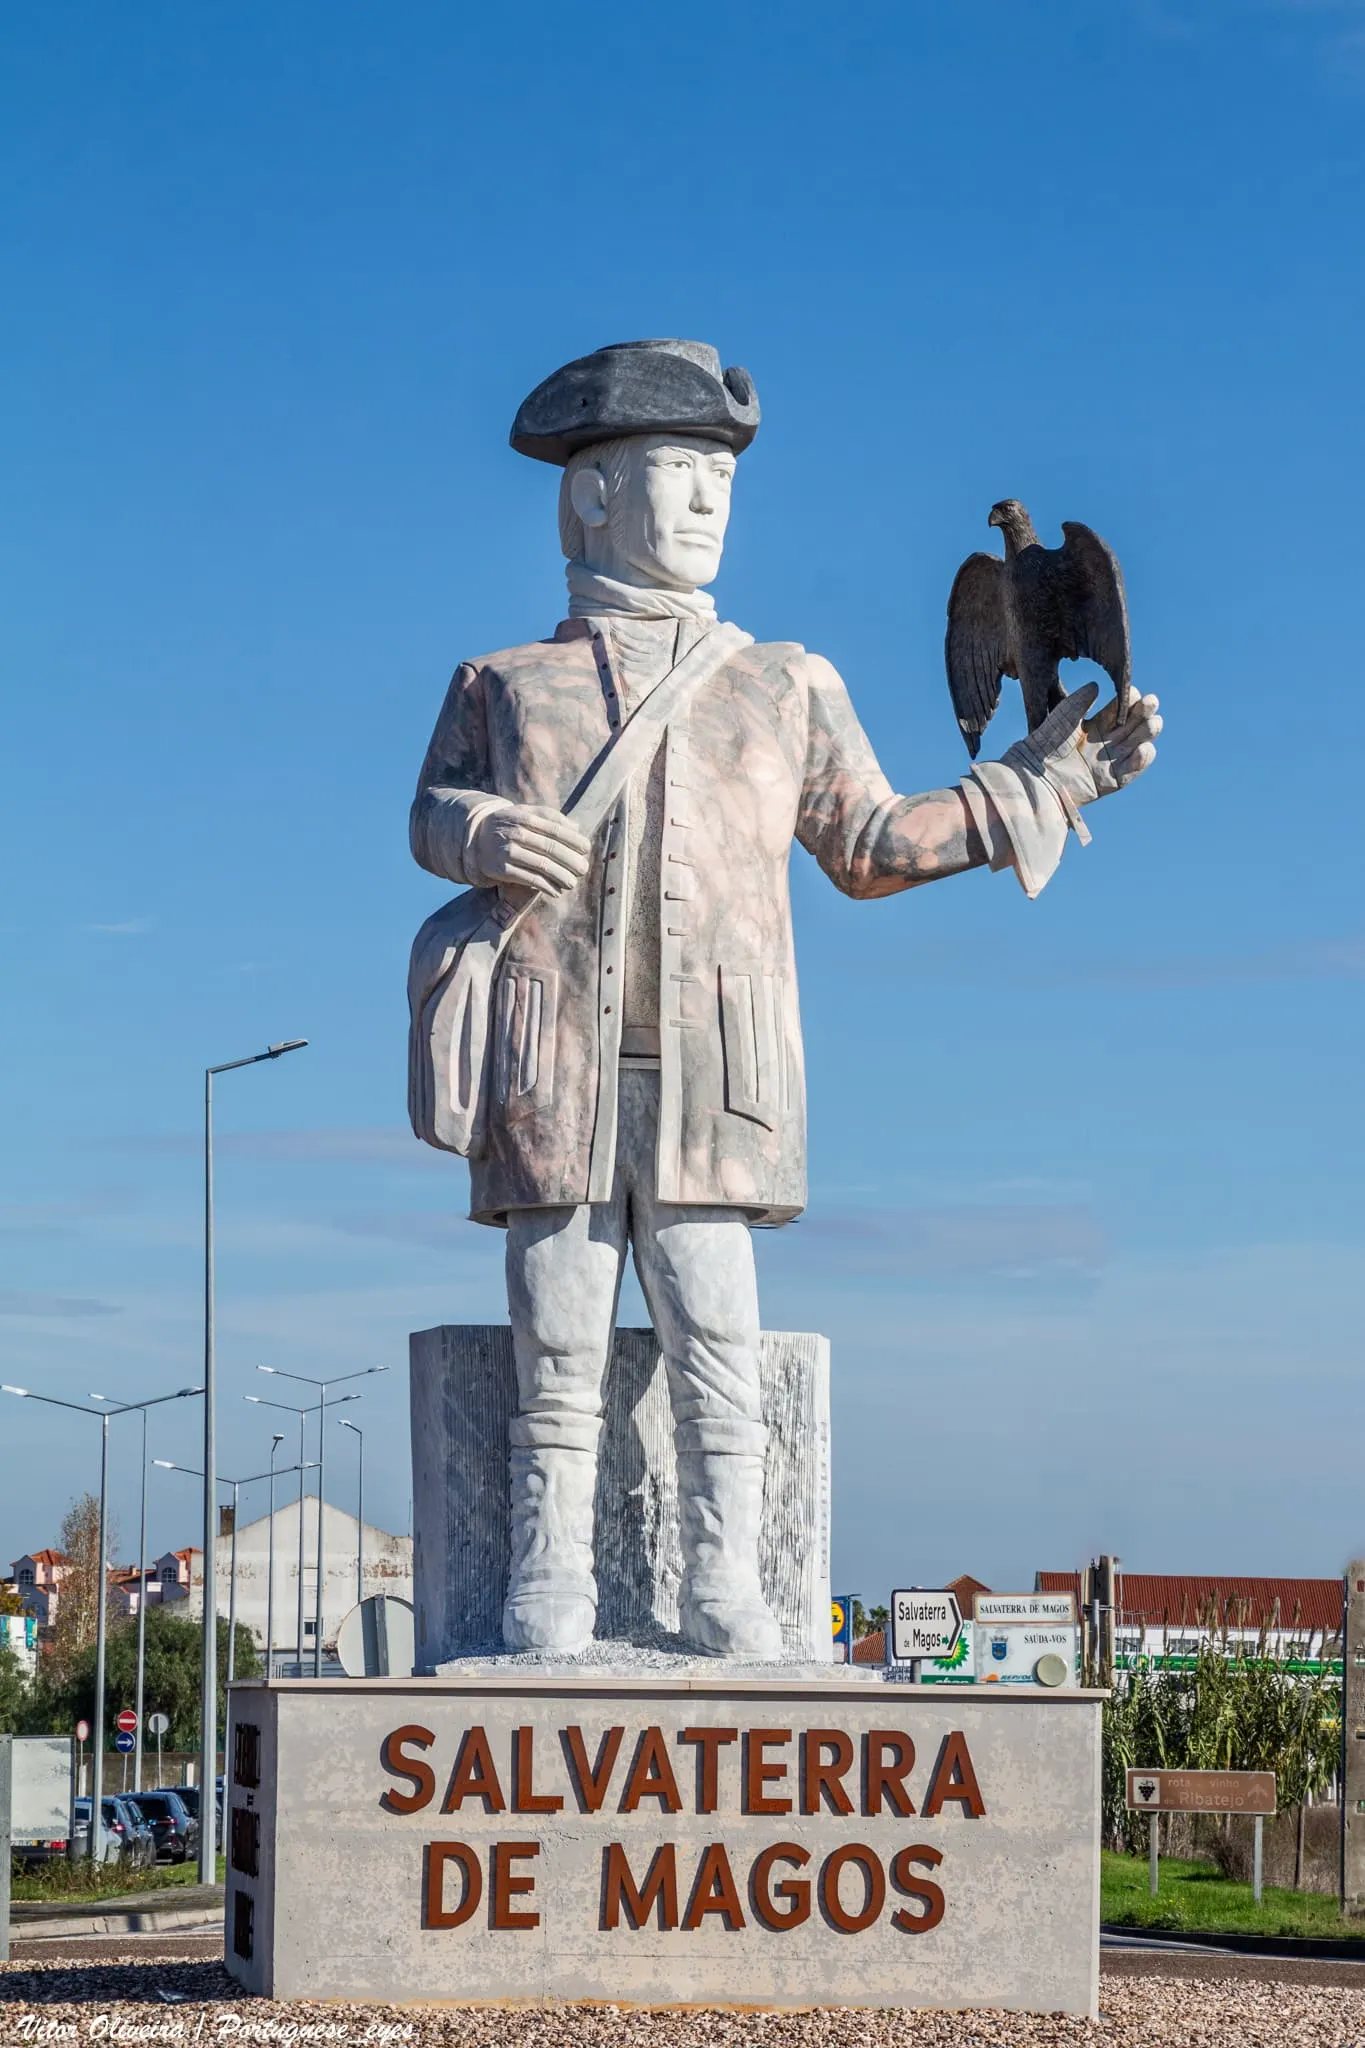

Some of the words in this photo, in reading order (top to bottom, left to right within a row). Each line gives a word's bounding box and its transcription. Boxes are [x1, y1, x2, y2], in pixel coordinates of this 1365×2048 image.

[898, 1601, 946, 1621] Salvaterra
[980, 1604, 1026, 1614] SALVATERRA
[1029, 1604, 1040, 1613] DE
[1042, 1604, 1069, 1614] MAGOS
[904, 1640, 910, 1648] de
[913, 1629, 941, 1651] Magos
[381, 1724, 986, 1817] SALVATERRA
[1168, 1778, 1191, 1788] rota
[1209, 1778, 1240, 1788] vinho
[1180, 1792, 1244, 1807] Ribatejo
[424, 1841, 540, 1928] DE
[601, 1841, 945, 1932] MAGOS
